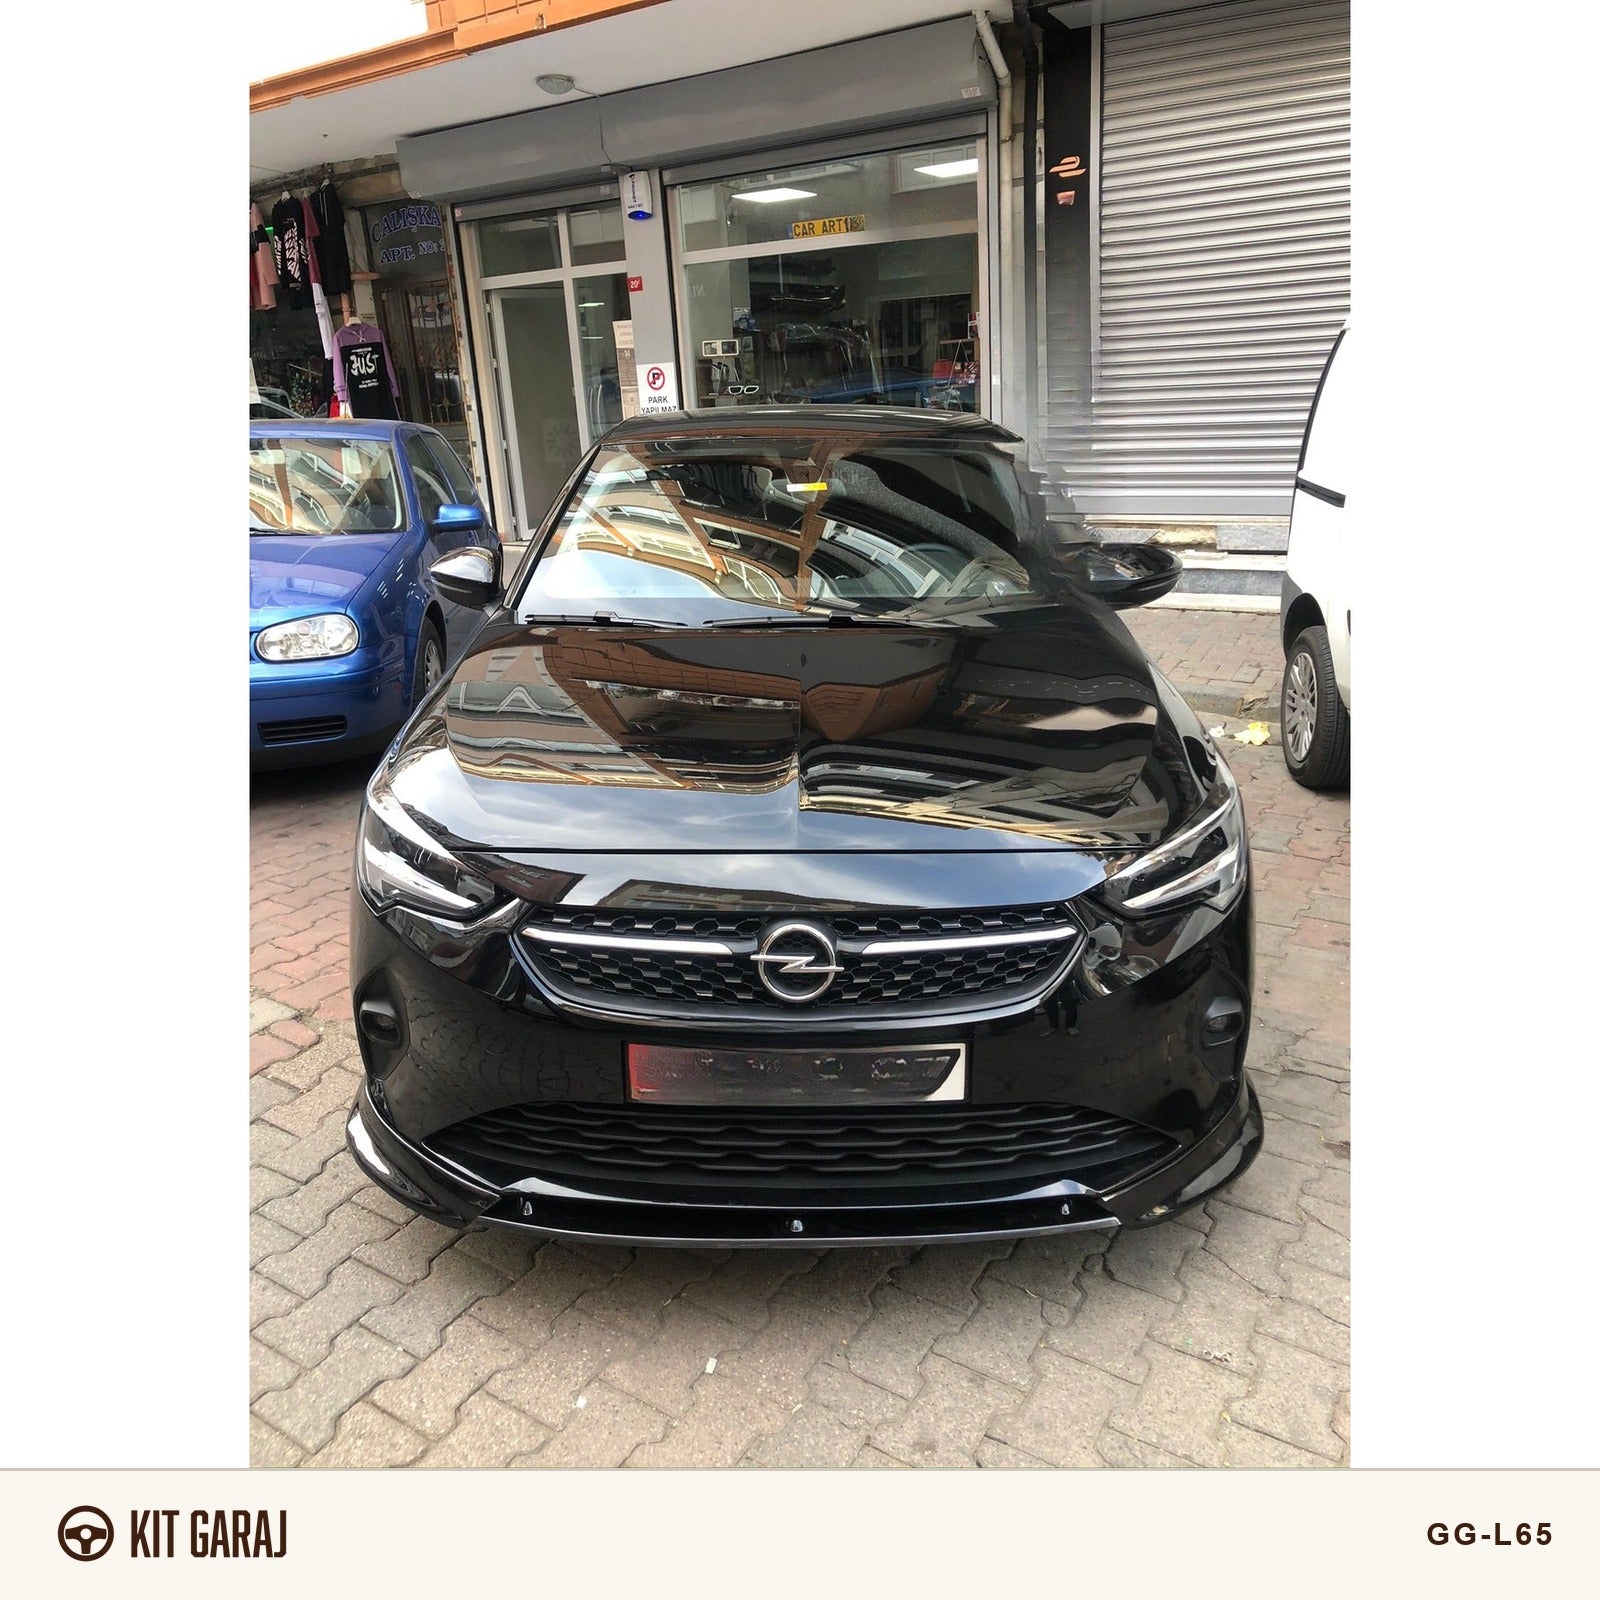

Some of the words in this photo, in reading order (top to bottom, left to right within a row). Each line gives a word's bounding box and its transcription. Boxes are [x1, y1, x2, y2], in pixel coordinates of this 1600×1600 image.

[793, 222, 815, 237] CAR
[380, 245, 416, 263] APT.
[648, 395, 668, 404] PARK
